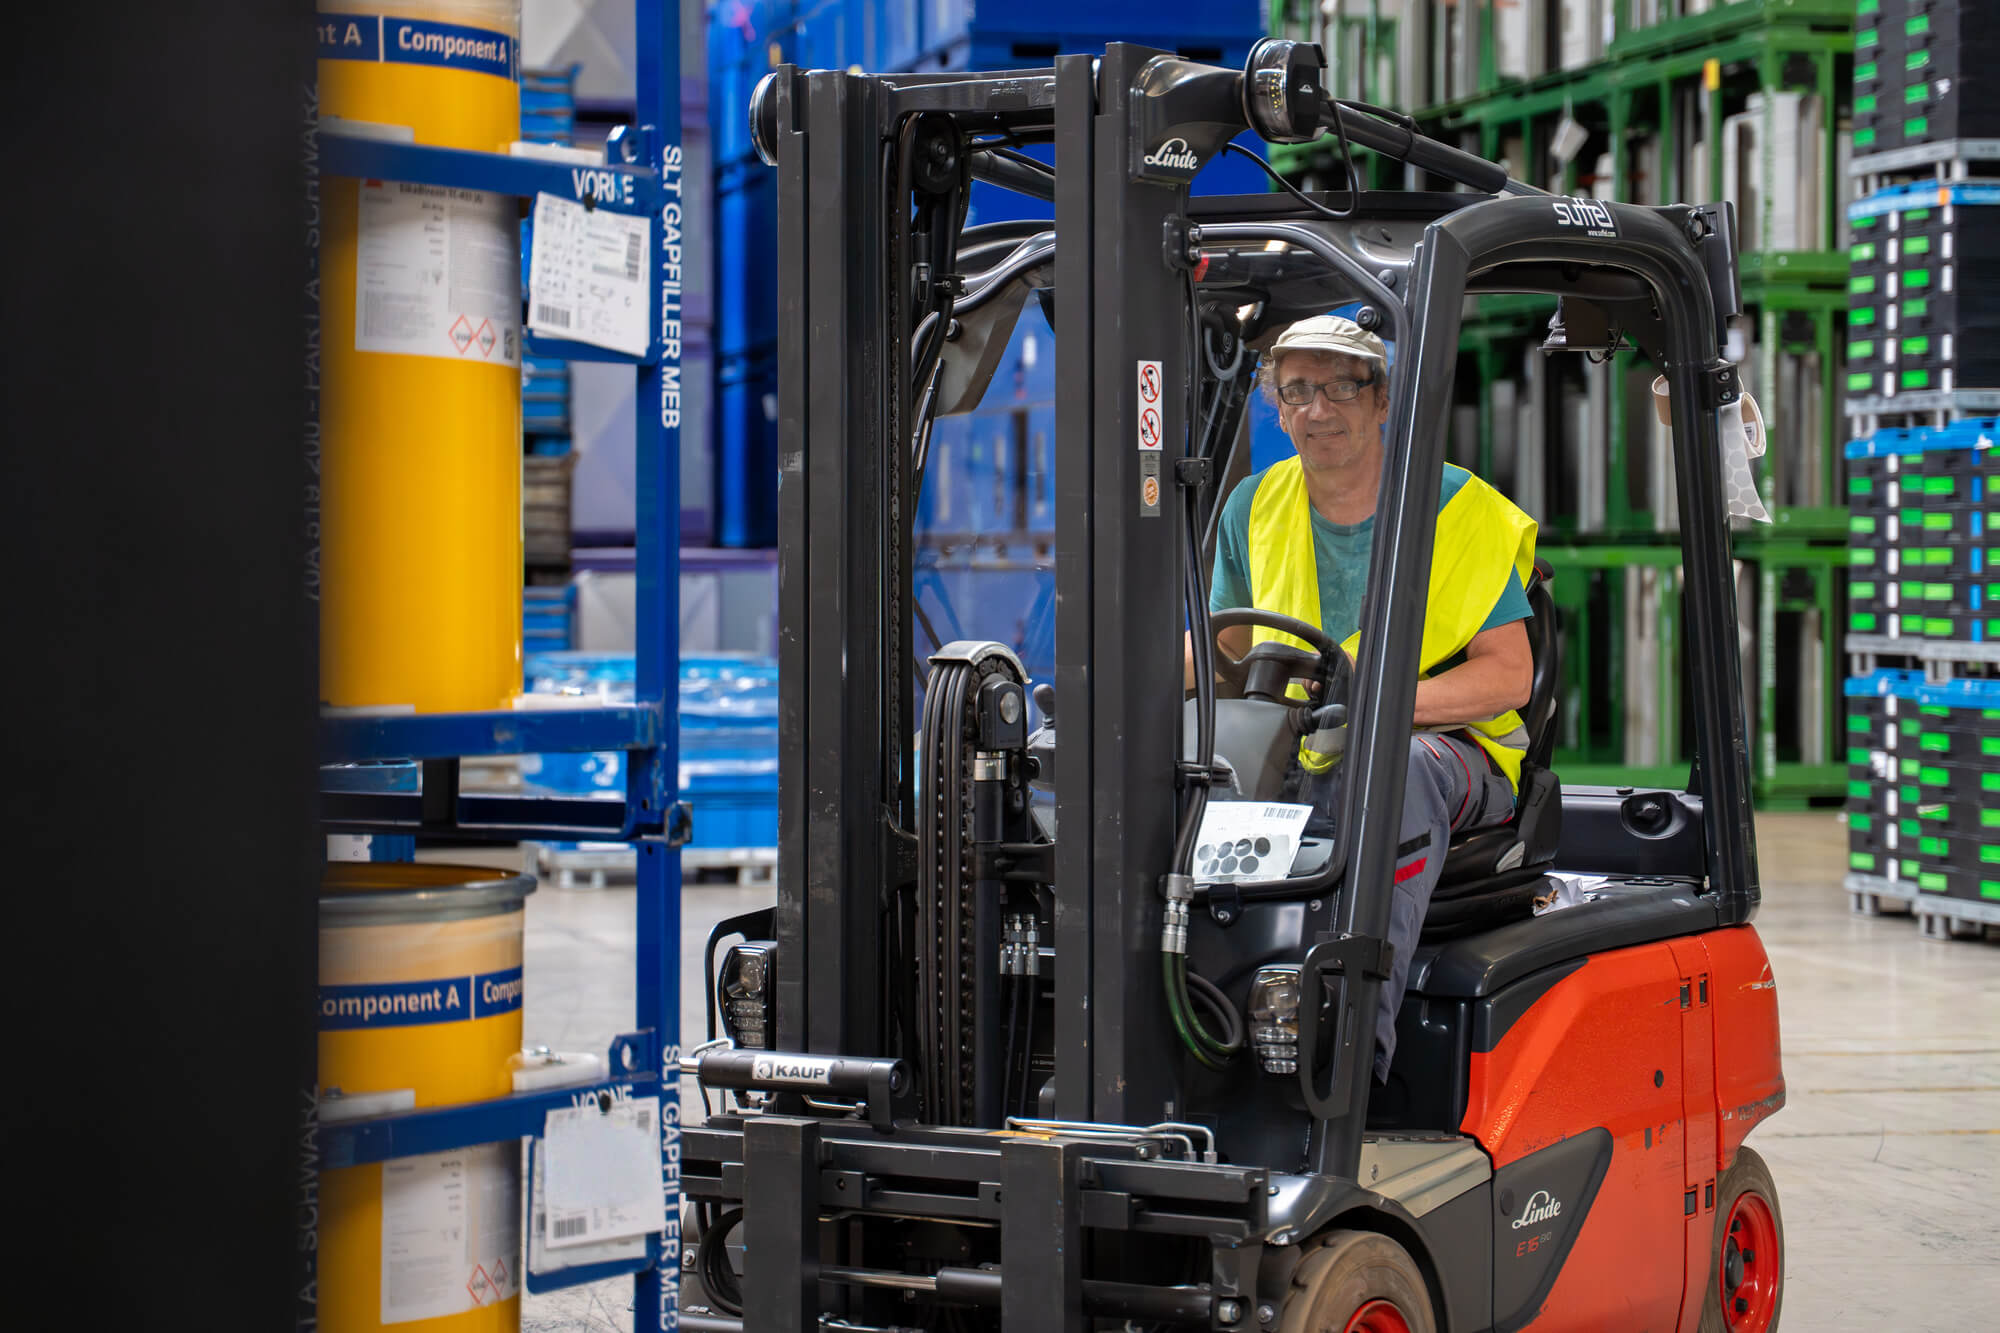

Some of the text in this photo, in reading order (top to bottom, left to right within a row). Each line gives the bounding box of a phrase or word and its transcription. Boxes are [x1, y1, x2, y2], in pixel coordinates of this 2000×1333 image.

[398, 26, 497, 60] Component
[498, 41, 507, 64] A
[1144, 137, 1198, 170] Linde
[661, 143, 682, 428] SLT GAPFILLER MEB
[445, 984, 461, 1010] A
[662, 1044, 681, 1095] SLT
[775, 1064, 826, 1080] KAUP
[296, 1083, 319, 1252] SCHWARZ
[1511, 1190, 1561, 1229] Linde
